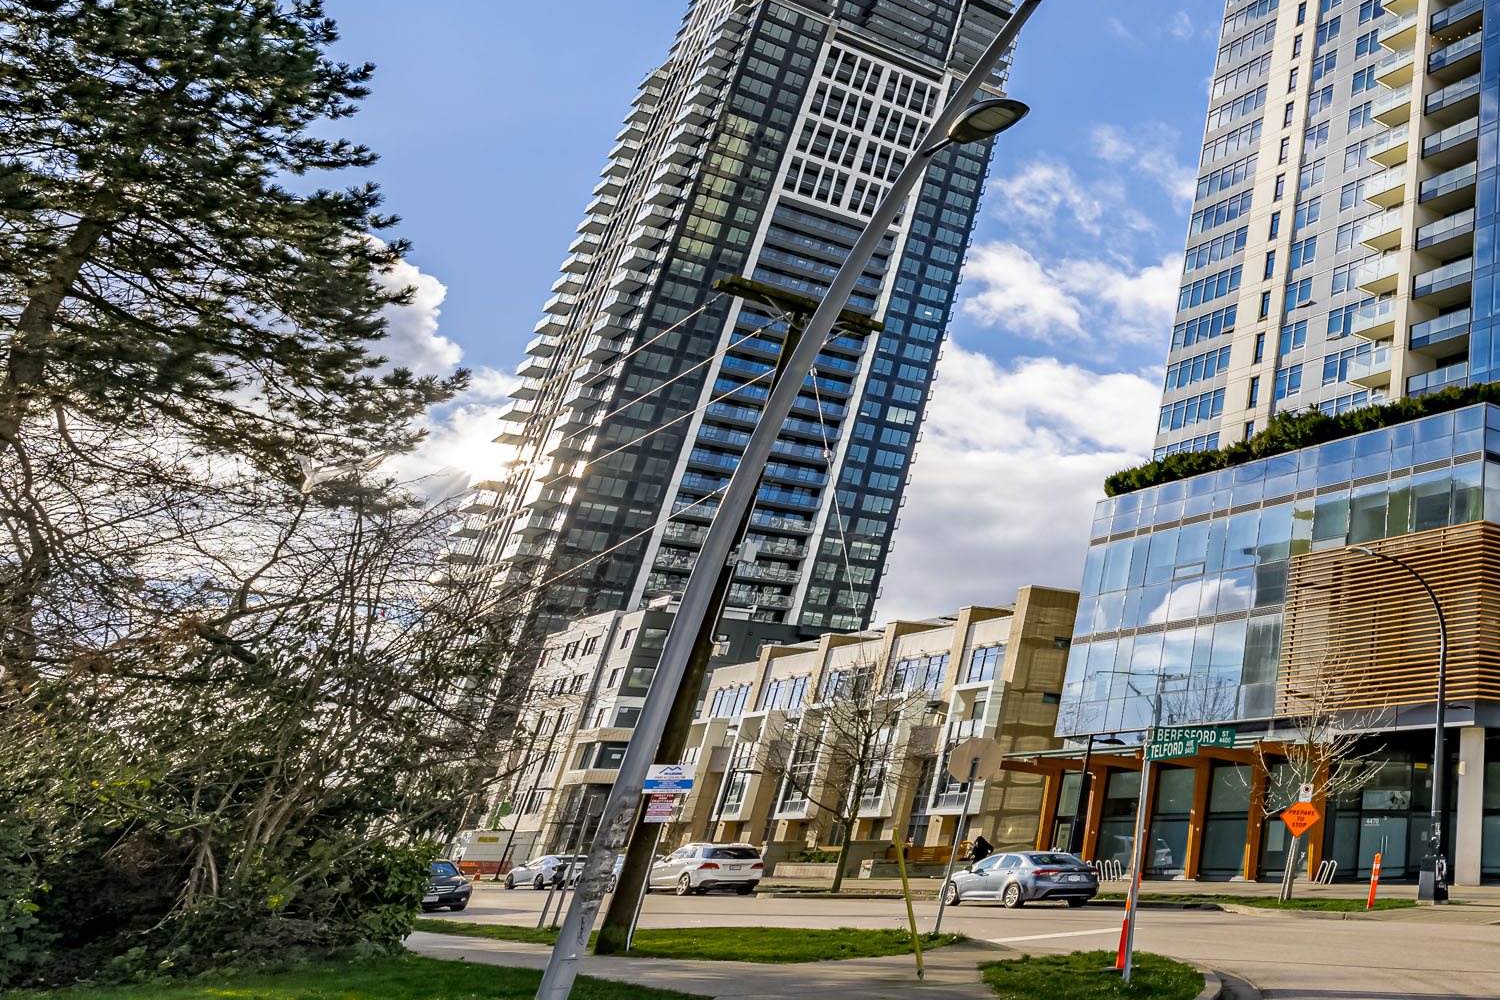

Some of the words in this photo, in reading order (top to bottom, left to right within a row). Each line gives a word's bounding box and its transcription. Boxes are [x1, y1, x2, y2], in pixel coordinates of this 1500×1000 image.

[1157, 728, 1217, 744] BERESFORD
[1151, 741, 1184, 759] TELFORD
[1185, 739, 1195, 747] AVE
